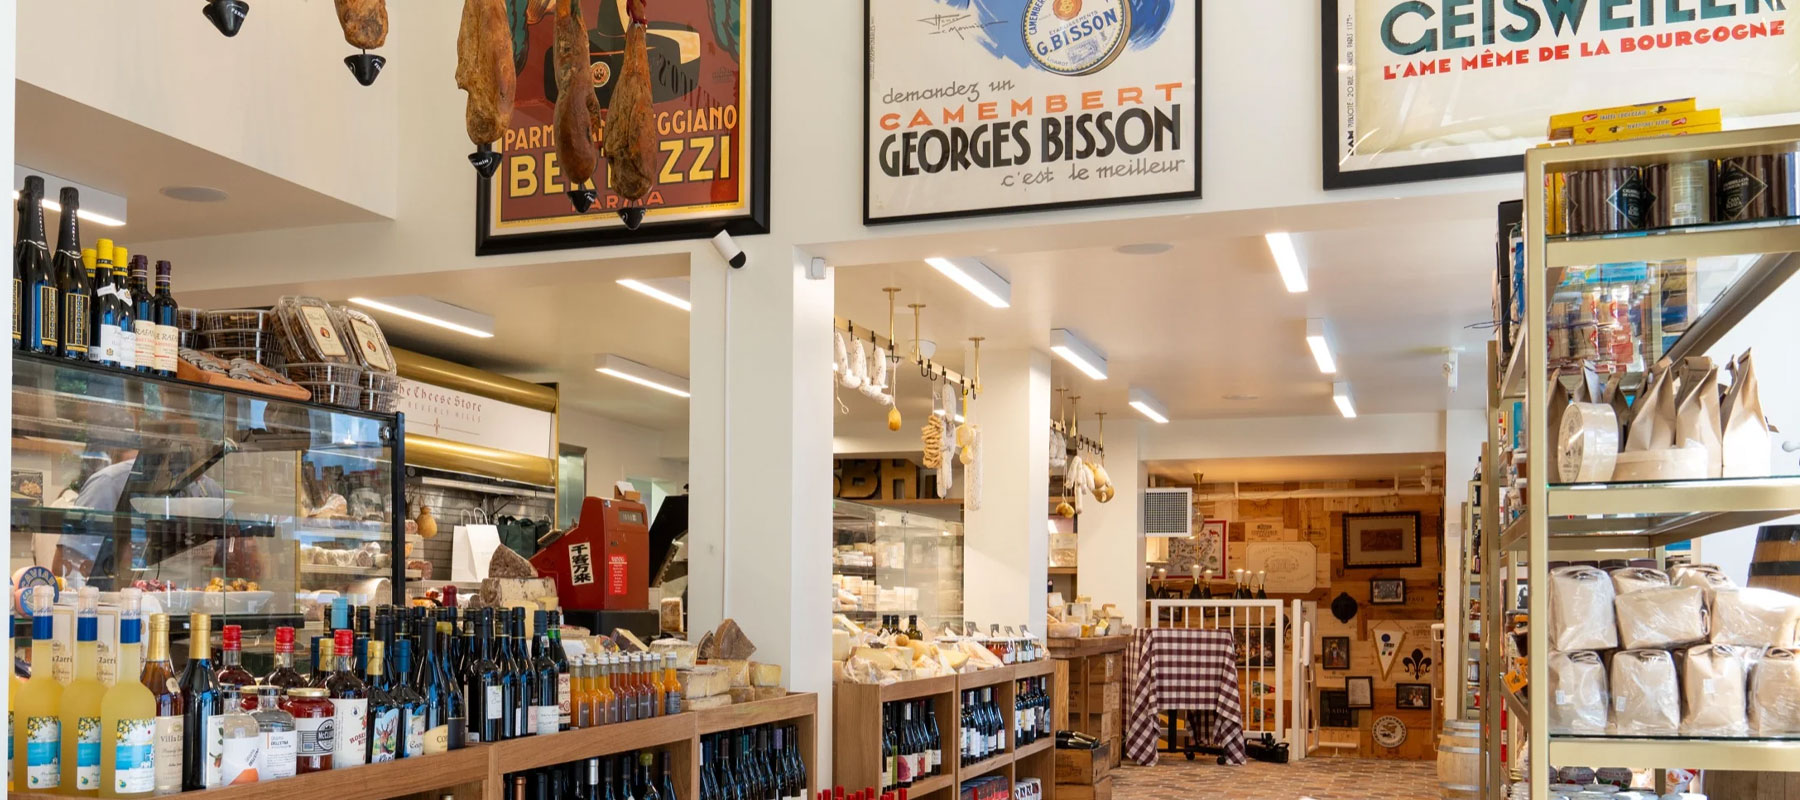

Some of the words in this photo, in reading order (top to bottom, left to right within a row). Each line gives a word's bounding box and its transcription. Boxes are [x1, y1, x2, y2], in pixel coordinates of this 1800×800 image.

[1380, 0, 1787, 56] GEISWE
[1383, 59, 1451, 81] L'AME
[1461, 49, 1530, 71] MÊME
[1538, 44, 1570, 62] DE
[1580, 38, 1610, 58] LA
[1620, 20, 1785, 53] BOURGOGNE
[879, 82, 1183, 131] CAMEMBERT
[882, 81, 980, 105] demandez
[988, 79, 1015, 94] un
[509, 134, 731, 198] BEZZI
[878, 120, 1032, 178] GEORGES
[1041, 103, 1181, 163] BISSON
[1068, 162, 1090, 181] le
[1095, 157, 1186, 179] meilleur
[399, 383, 411, 396] he
[414, 386, 451, 405] Cheese
[454, 395, 482, 412] Store
